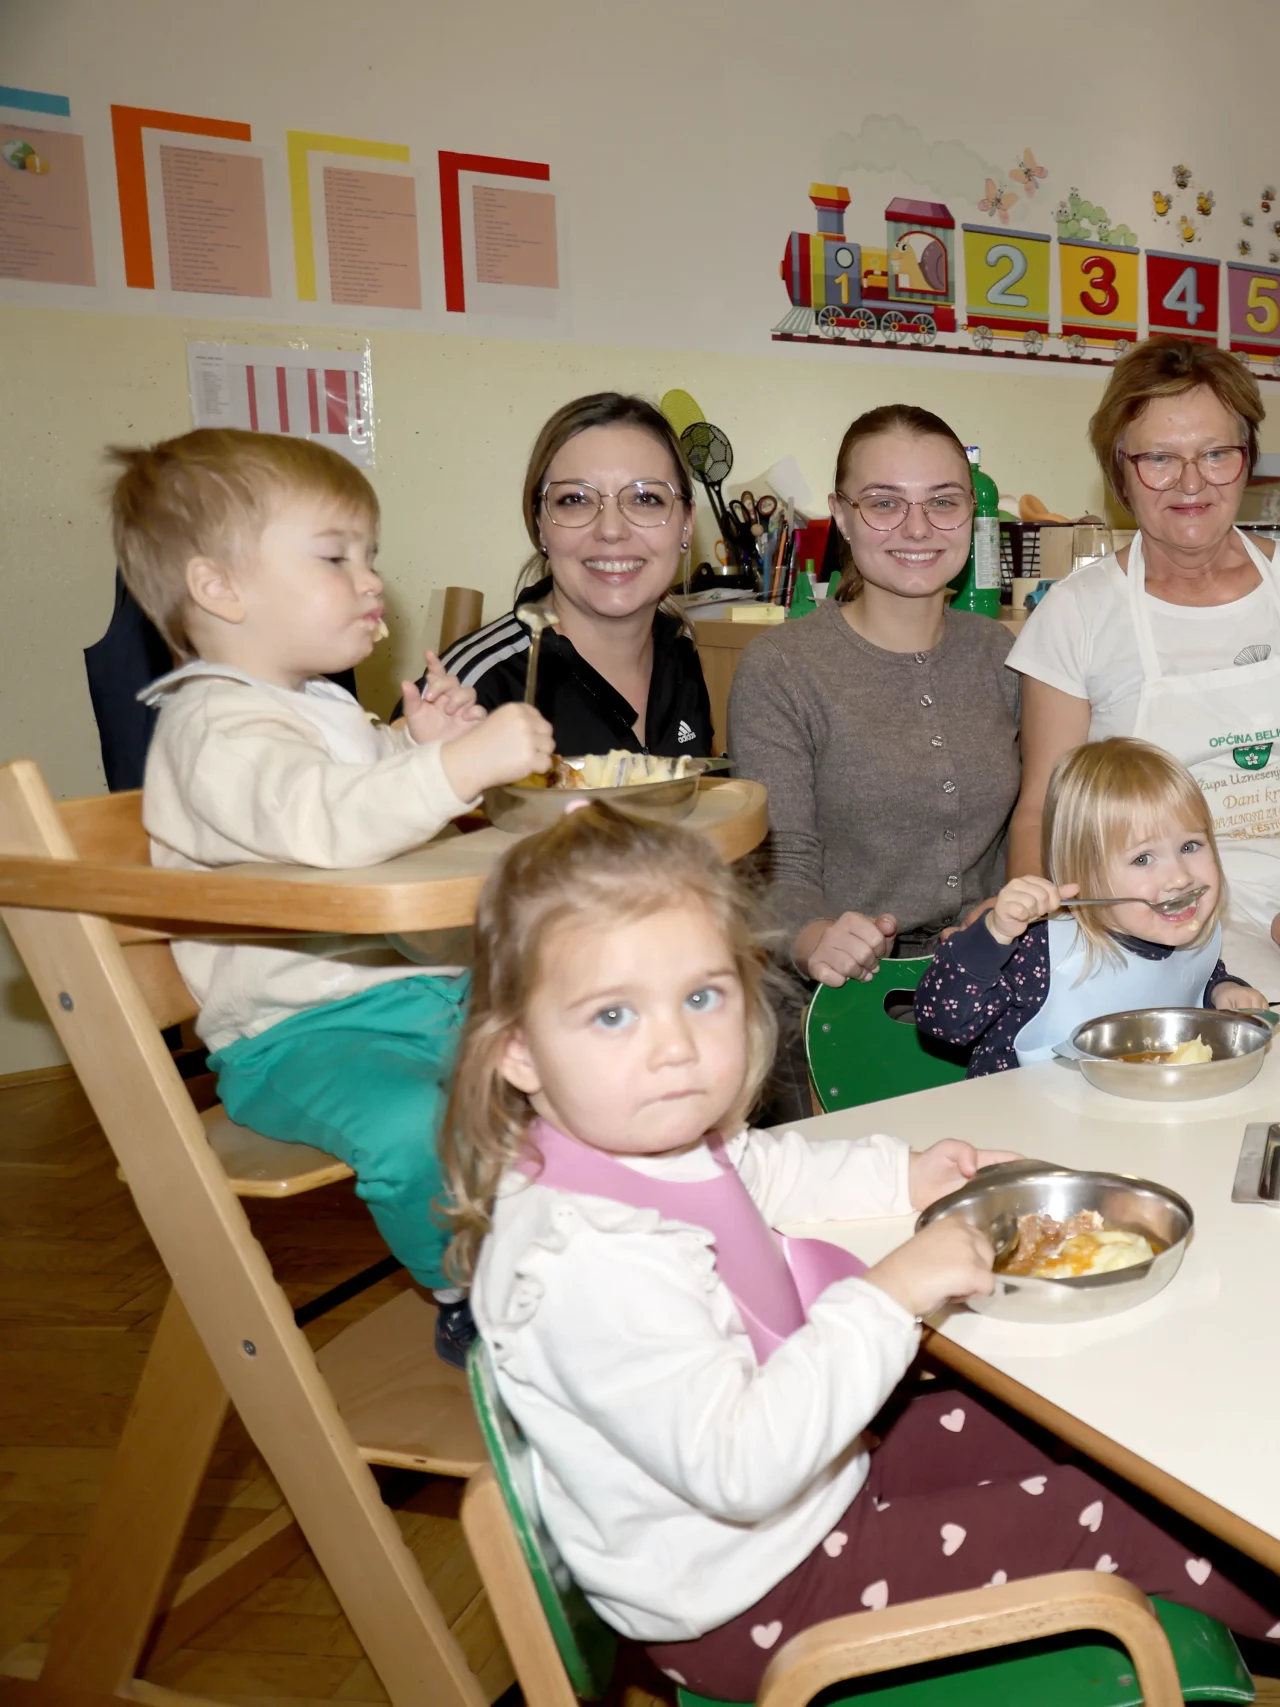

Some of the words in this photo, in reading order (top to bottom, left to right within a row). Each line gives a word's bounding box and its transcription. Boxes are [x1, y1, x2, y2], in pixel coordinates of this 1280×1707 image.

[834, 272, 849, 305] 1
[986, 244, 1029, 307] 2
[1080, 256, 1119, 316] 3
[1162, 267, 1205, 326] 4
[1246, 276, 1280, 334] 5
[1208, 732, 1253, 748] OPĆINA
[1222, 788, 1260, 809] Dani
[1266, 807, 1279, 820] ZA
